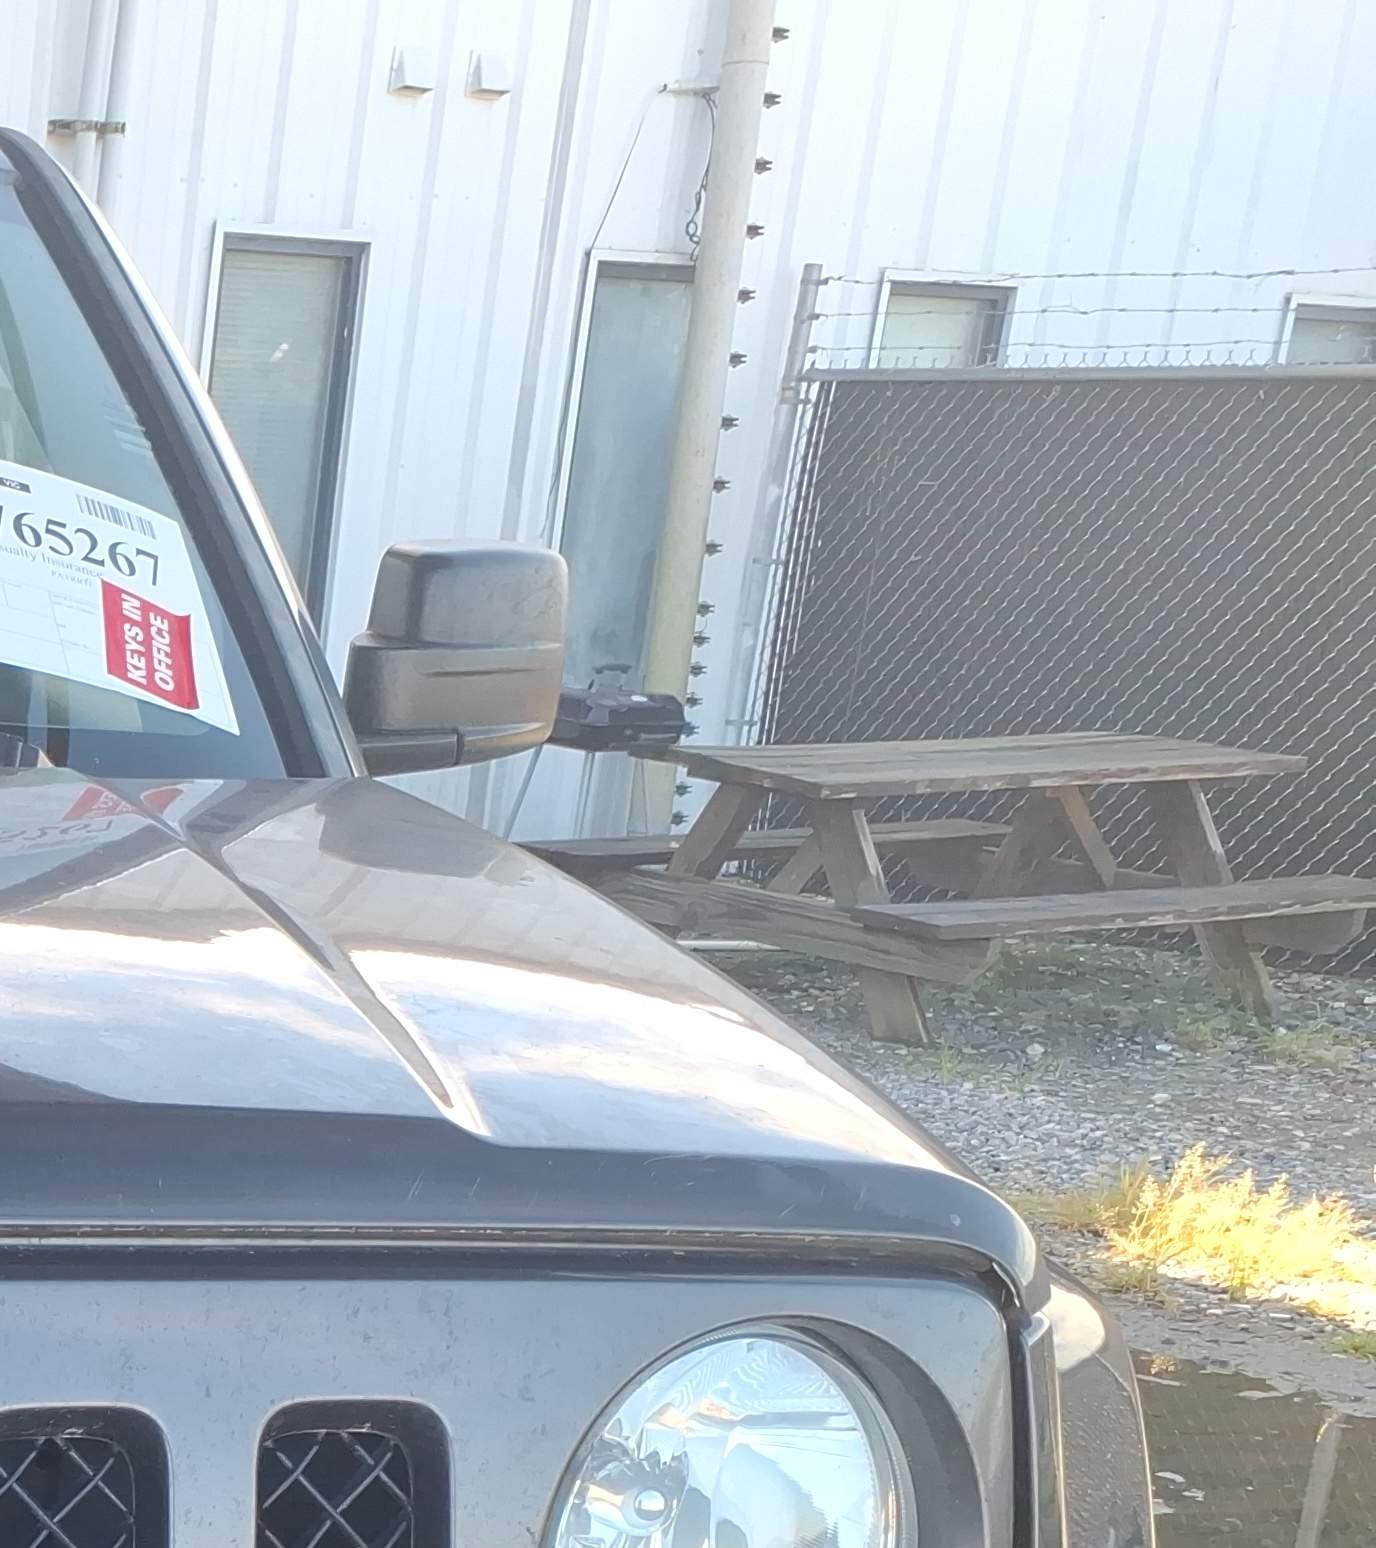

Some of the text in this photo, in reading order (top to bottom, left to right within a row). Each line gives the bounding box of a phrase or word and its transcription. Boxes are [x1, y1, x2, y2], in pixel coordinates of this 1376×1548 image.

[121, 592, 147, 686] KEYS IN
[149, 611, 176, 692] OFFICE
